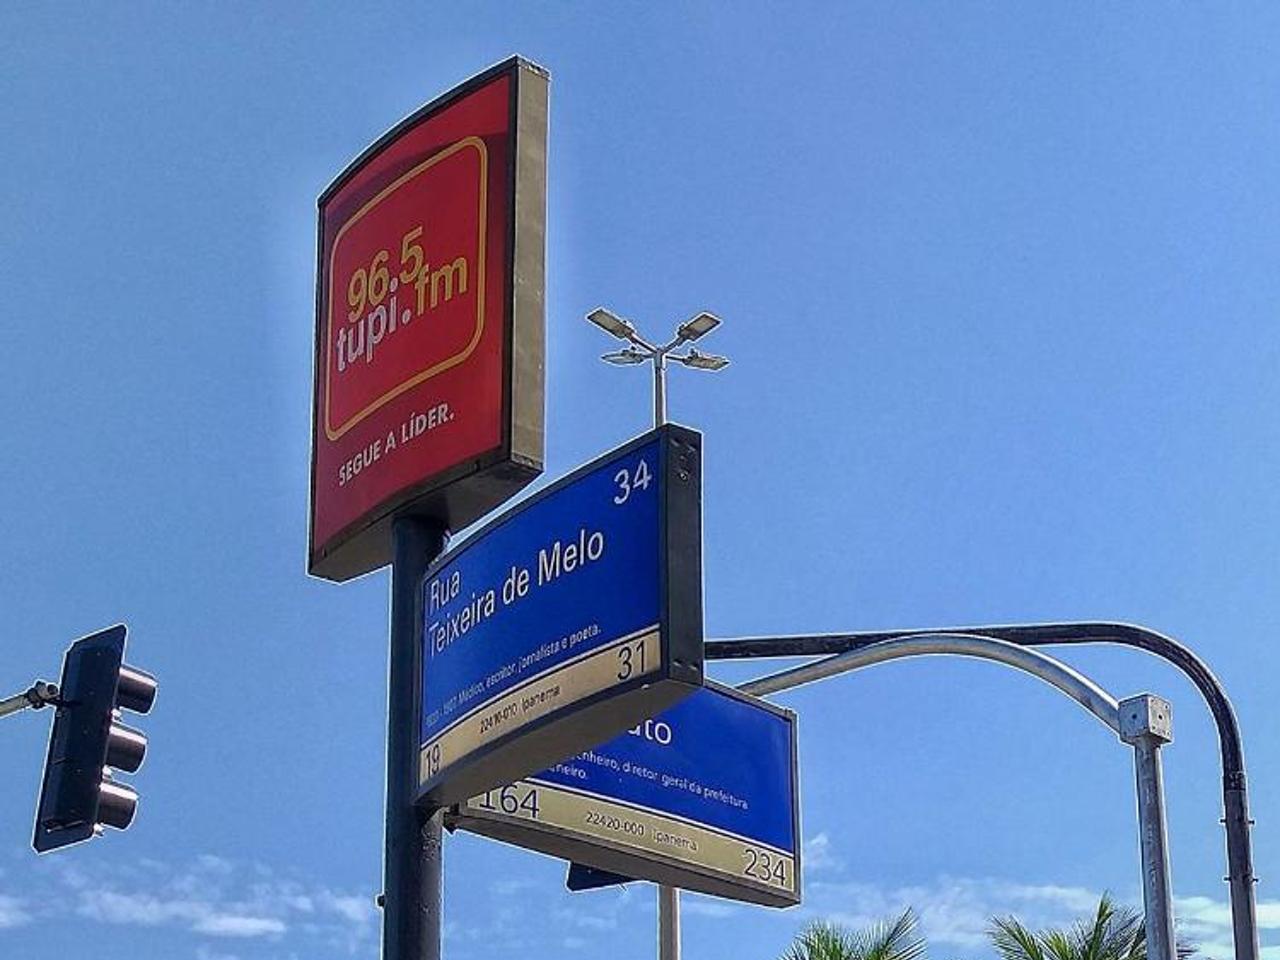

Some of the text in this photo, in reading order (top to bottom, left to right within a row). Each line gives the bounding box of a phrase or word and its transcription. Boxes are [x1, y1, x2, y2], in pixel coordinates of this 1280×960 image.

[338, 402, 455, 487] SEGUE A LÍDER.
[613, 459, 652, 505] 34
[428, 529, 604, 658] Teixeira de Melo
[430, 570, 461, 617] Rua
[561, 637, 568, 649] e
[617, 640, 648, 680] 31
[521, 685, 561, 713] Ipanema
[425, 743, 441, 778] 19
[480, 784, 540, 818] 164
[623, 761, 659, 780] diretor
[661, 773, 687, 790] geral
[688, 781, 702, 794] da
[703, 786, 749, 811] prefeitura
[586, 811, 698, 852] 22420-000 Ipanema
[743, 849, 786, 886] 234
